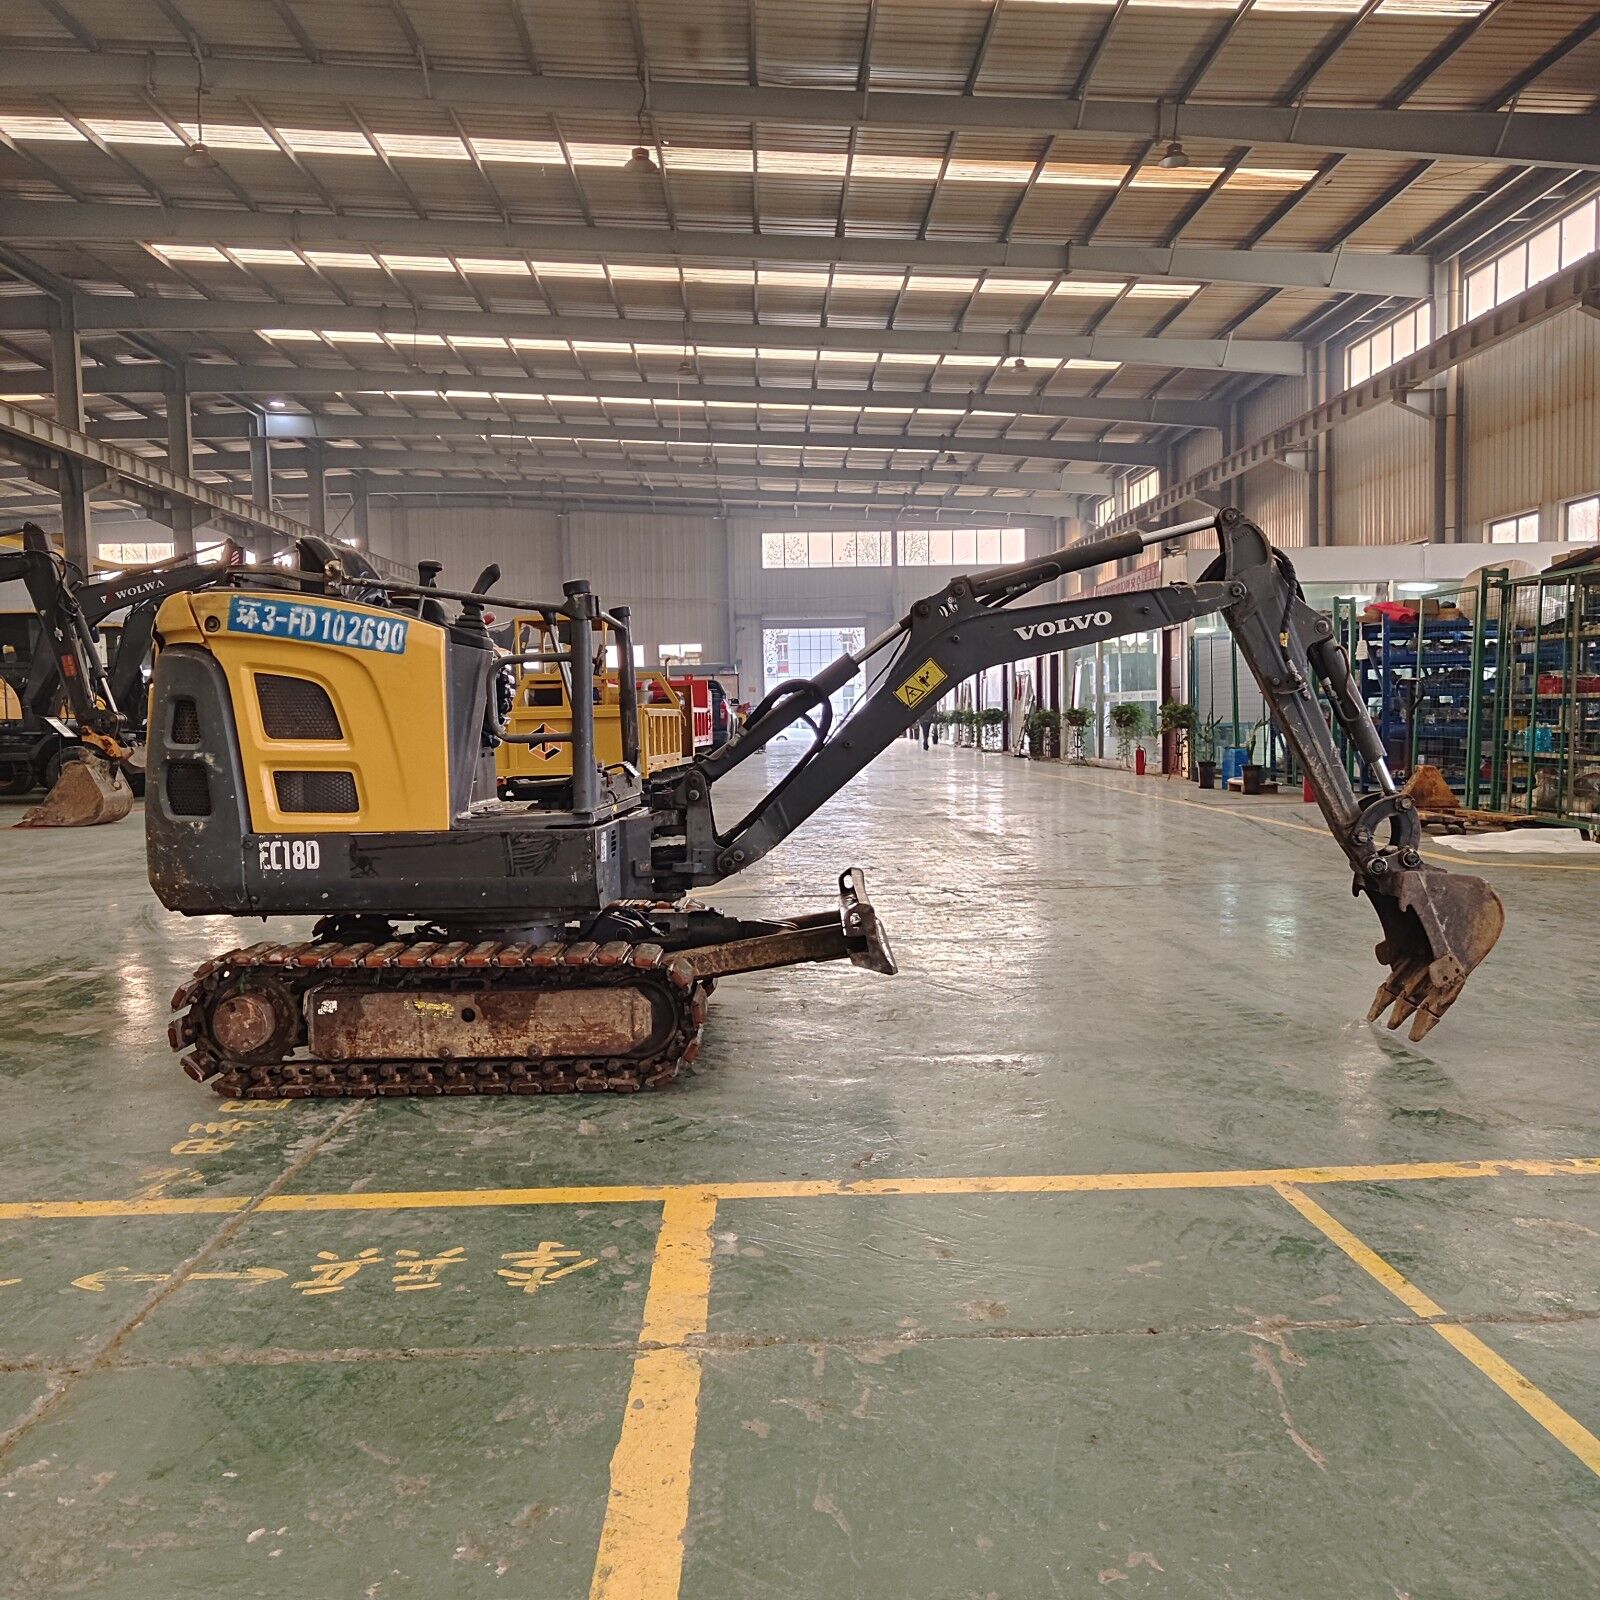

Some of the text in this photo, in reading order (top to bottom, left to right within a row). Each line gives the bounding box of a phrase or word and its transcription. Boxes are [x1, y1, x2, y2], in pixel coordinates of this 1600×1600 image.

[115, 579, 165, 599] WOLWA
[1013, 611, 1112, 640] VOLVO
[259, 840, 320, 870] EC18D
